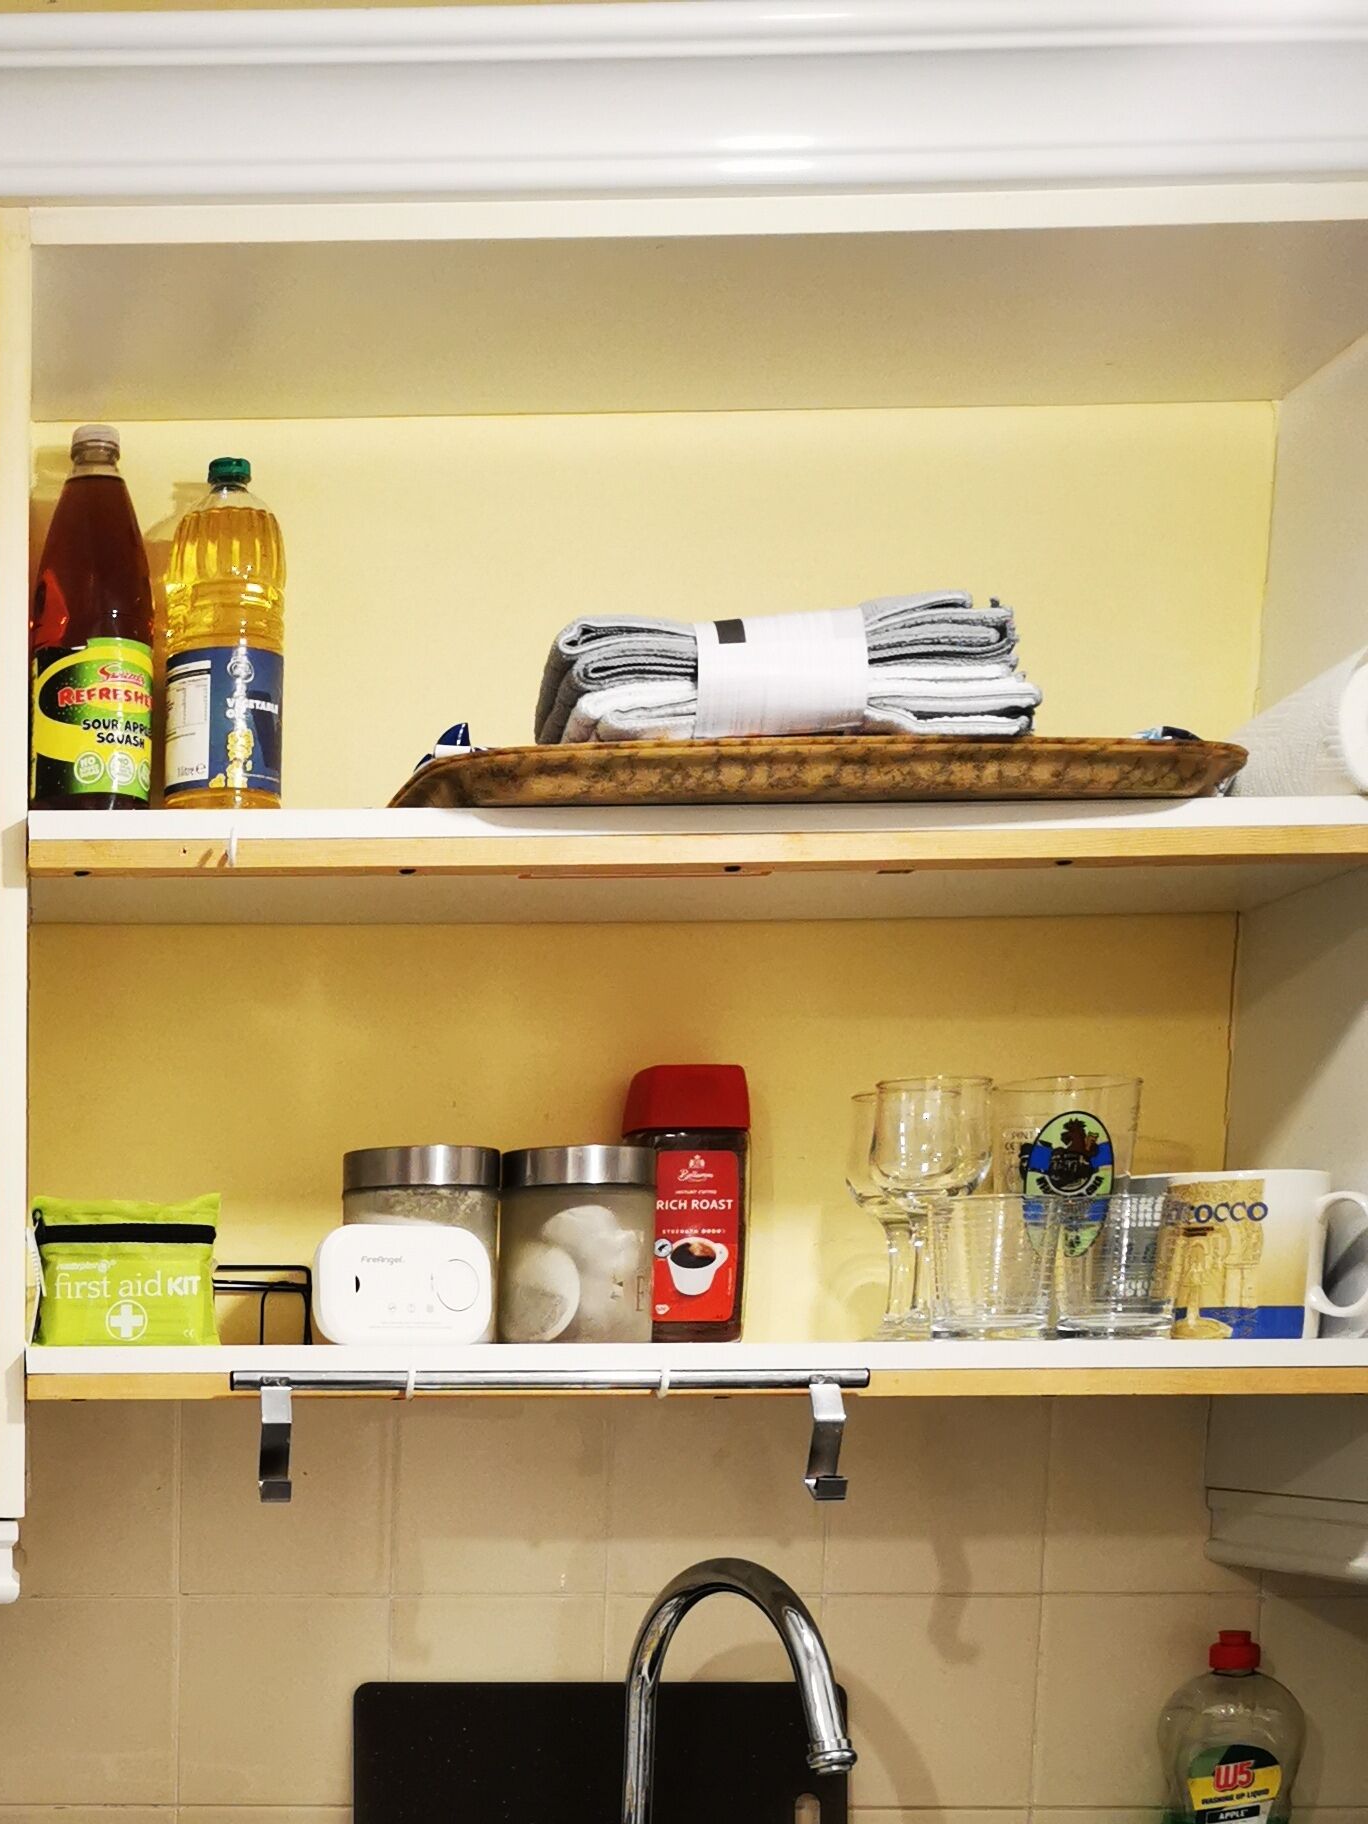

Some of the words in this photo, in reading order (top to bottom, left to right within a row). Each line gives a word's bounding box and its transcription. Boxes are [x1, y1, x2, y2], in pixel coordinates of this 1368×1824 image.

[57, 686, 152, 709] REFRESHE
[82, 719, 119, 730] SOUR
[96, 732, 145, 750] SQUASH
[656, 1200, 688, 1210] RICH
[691, 1199, 734, 1210] ROAST
[55, 1273, 111, 1299] first
[118, 1270, 162, 1297] aid
[167, 1275, 201, 1296] KIT
[1214, 1760, 1254, 1792] W5
[1218, 1810, 1246, 1820] APPLE
